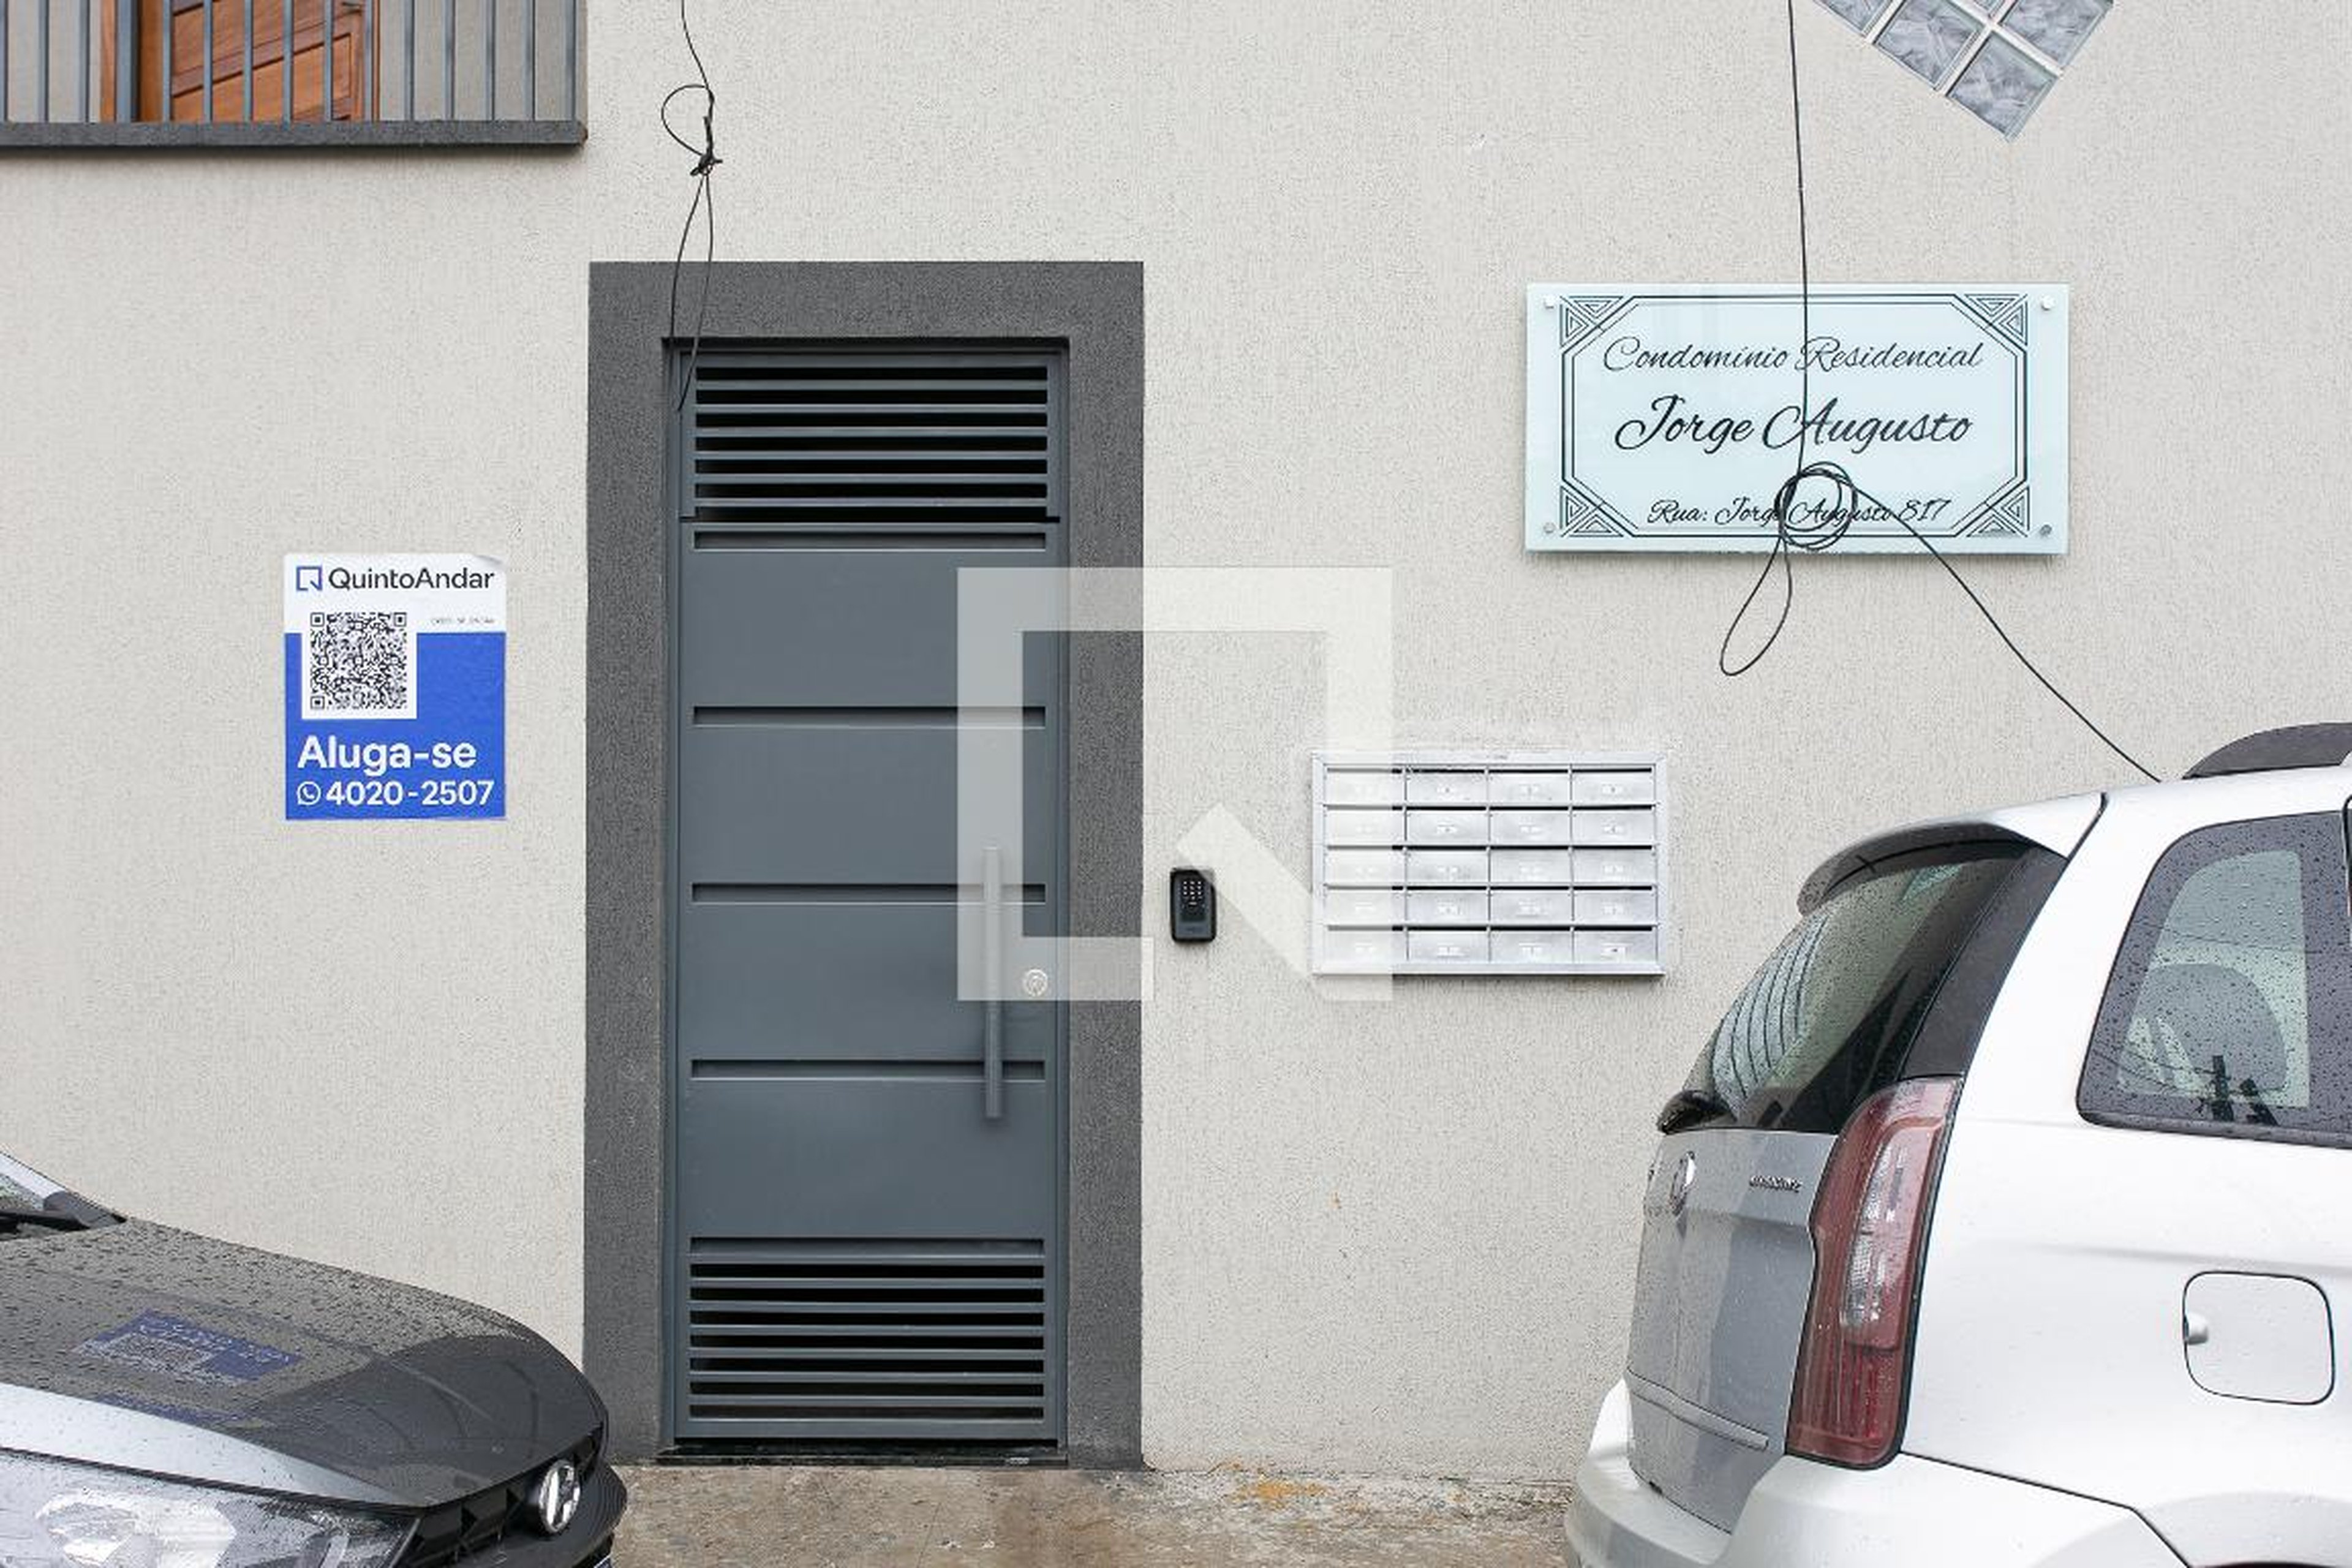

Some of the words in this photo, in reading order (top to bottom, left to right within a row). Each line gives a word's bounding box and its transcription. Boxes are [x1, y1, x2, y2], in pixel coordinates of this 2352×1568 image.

[1793, 336, 1985, 372] Residencial
[1615, 394, 1755, 454] Jorge
[1762, 397, 1973, 454] Augusto
[1647, 499, 1709, 524] Rua:
[1898, 498, 1953, 522] 817
[328, 567, 495, 592] QuintoAndar
[297, 735, 477, 777] Aluga-se
